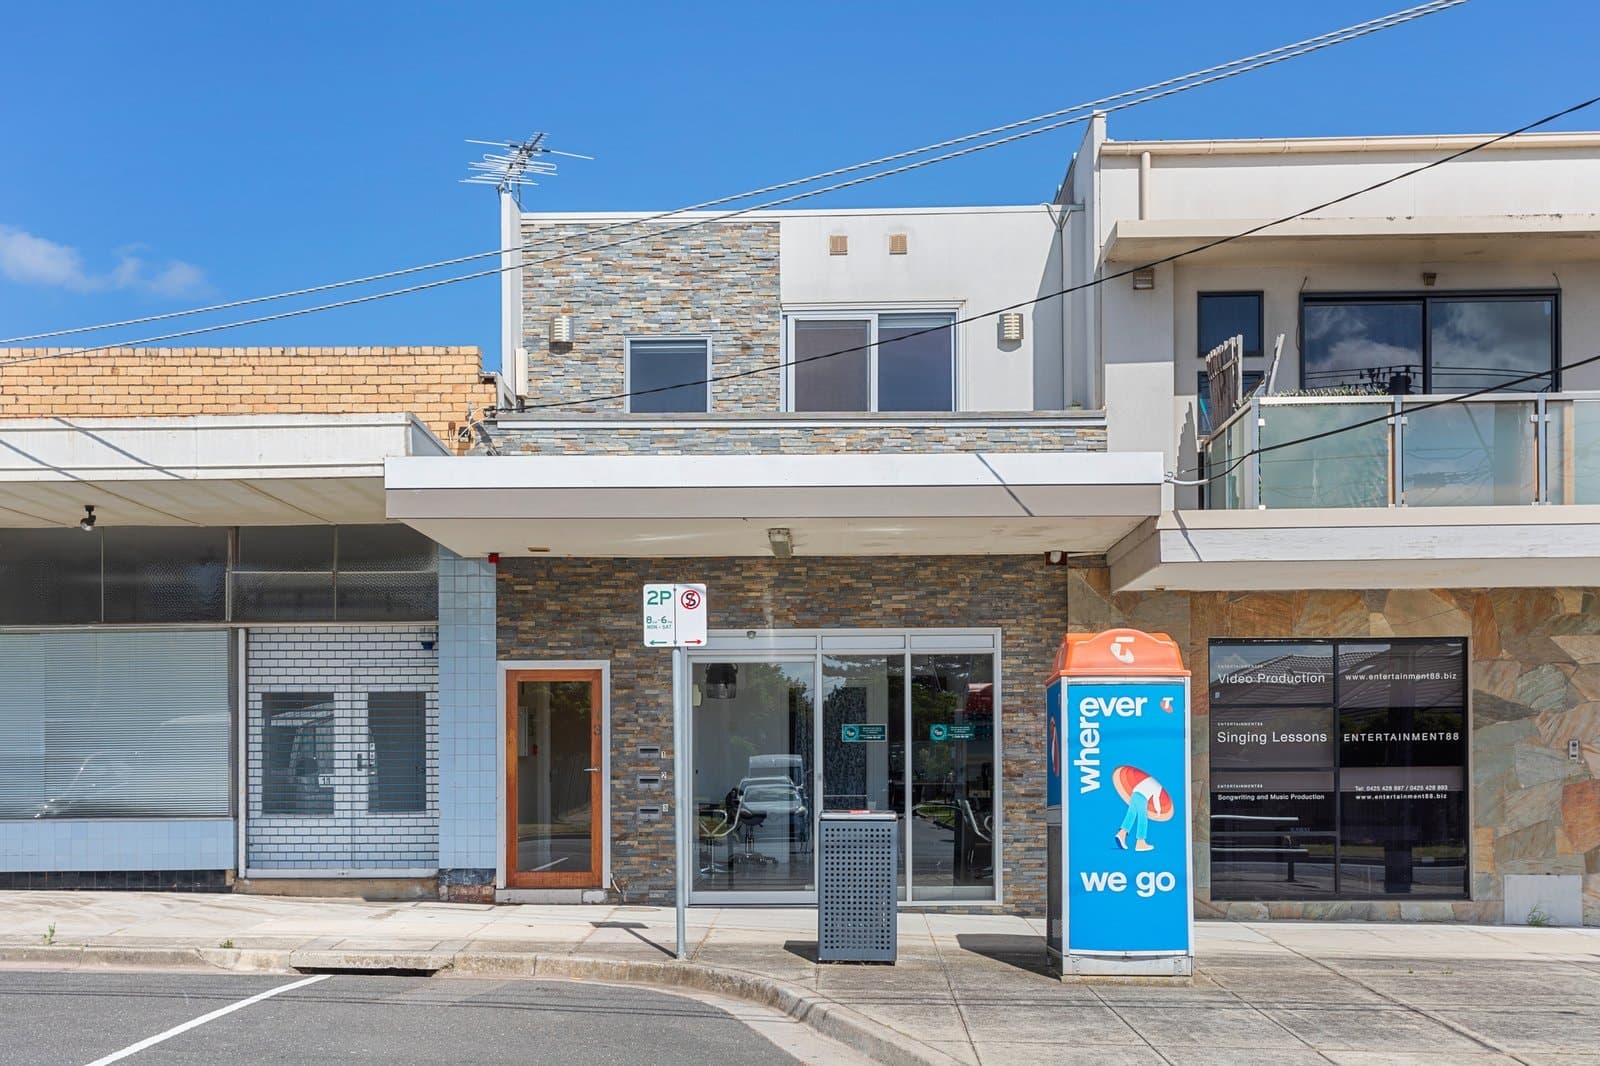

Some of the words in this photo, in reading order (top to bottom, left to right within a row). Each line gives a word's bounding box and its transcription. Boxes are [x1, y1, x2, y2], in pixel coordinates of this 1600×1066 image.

[647, 590, 672, 605] 2P
[1218, 673, 1253, 684] Video
[1257, 673, 1325, 684] Production
[1345, 671, 1457, 680] www.entertainment88.biz
[1217, 731, 1267, 745] Singing
[1272, 731, 1328, 742] Lessons
[1343, 732, 1460, 742] ENTERTAINMENT88
[1080, 871, 1127, 892] we
[1136, 871, 1176, 898] go
